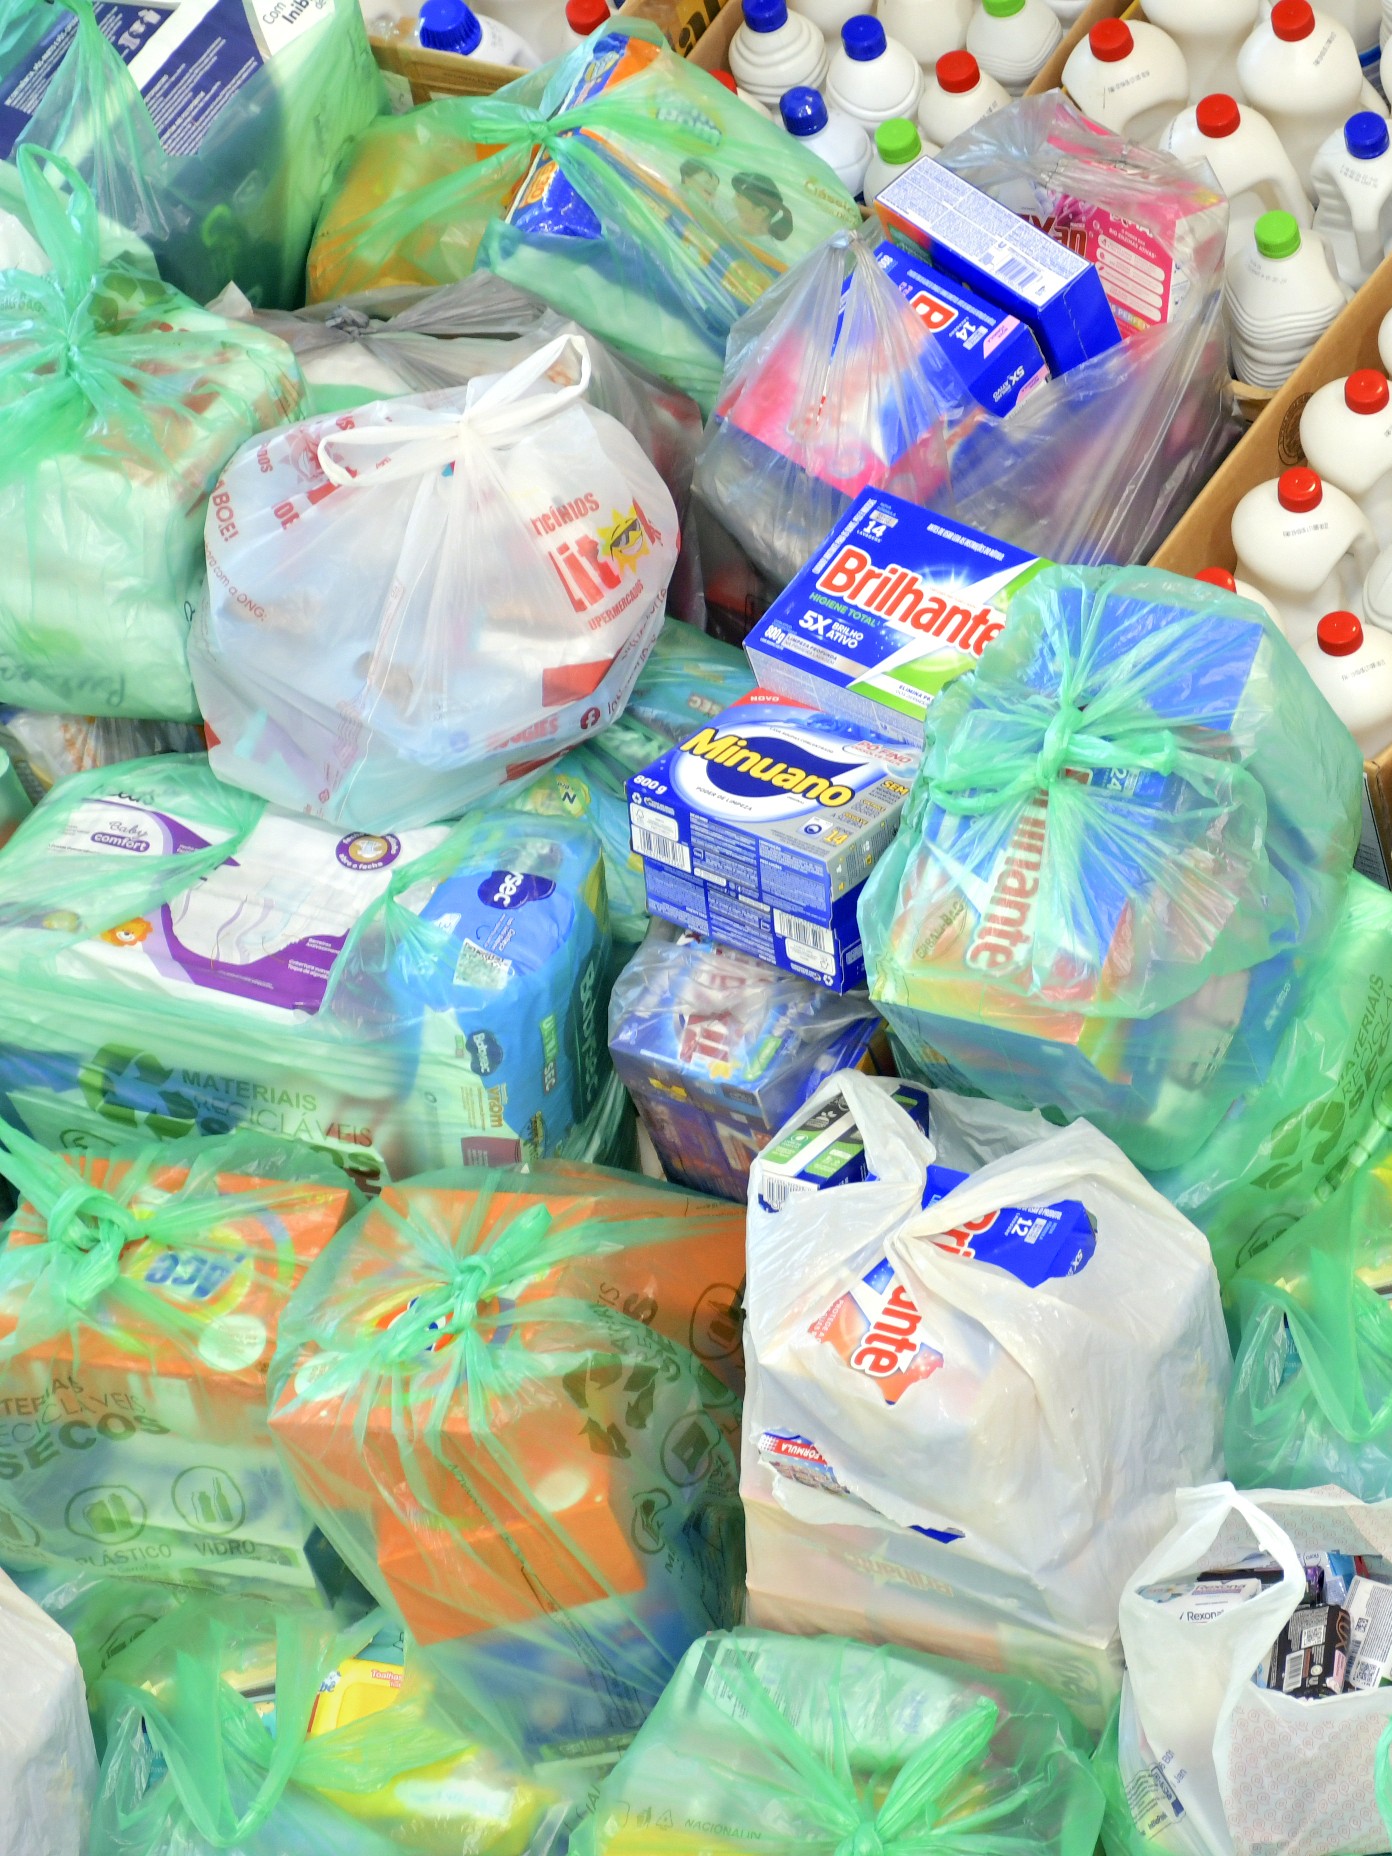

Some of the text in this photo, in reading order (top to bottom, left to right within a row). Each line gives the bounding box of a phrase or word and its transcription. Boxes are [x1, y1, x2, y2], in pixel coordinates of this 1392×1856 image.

[863, 520, 887, 540] 14
[587, 578, 645, 632] UPERMERCADOS
[808, 591, 847, 619] HIGIENE
[818, 546, 1006, 657] Brilhante
[798, 609, 832, 636] 5X
[831, 621, 864, 642] BRILHO
[825, 629, 859, 650] ATIVO
[750, 694, 780, 703] NOVO
[878, 749, 912, 764] FINO
[680, 727, 856, 808] Minuano
[632, 774, 659, 791] 800
[882, 779, 911, 796] SEM
[1109, 767, 1127, 792] 24
[695, 785, 717, 797] PODER
[724, 796, 754, 812] LIMPEZA
[107, 820, 149, 841] Baby
[822, 829, 850, 847] 14
[93, 831, 149, 852] comfort
[181, 1069, 318, 1113] MATERIAIS
[192, 1095, 374, 1148] RECICLÁVEIS
[1010, 1217, 1029, 1238] 12
[193, 1538, 257, 1557] VIDRO
